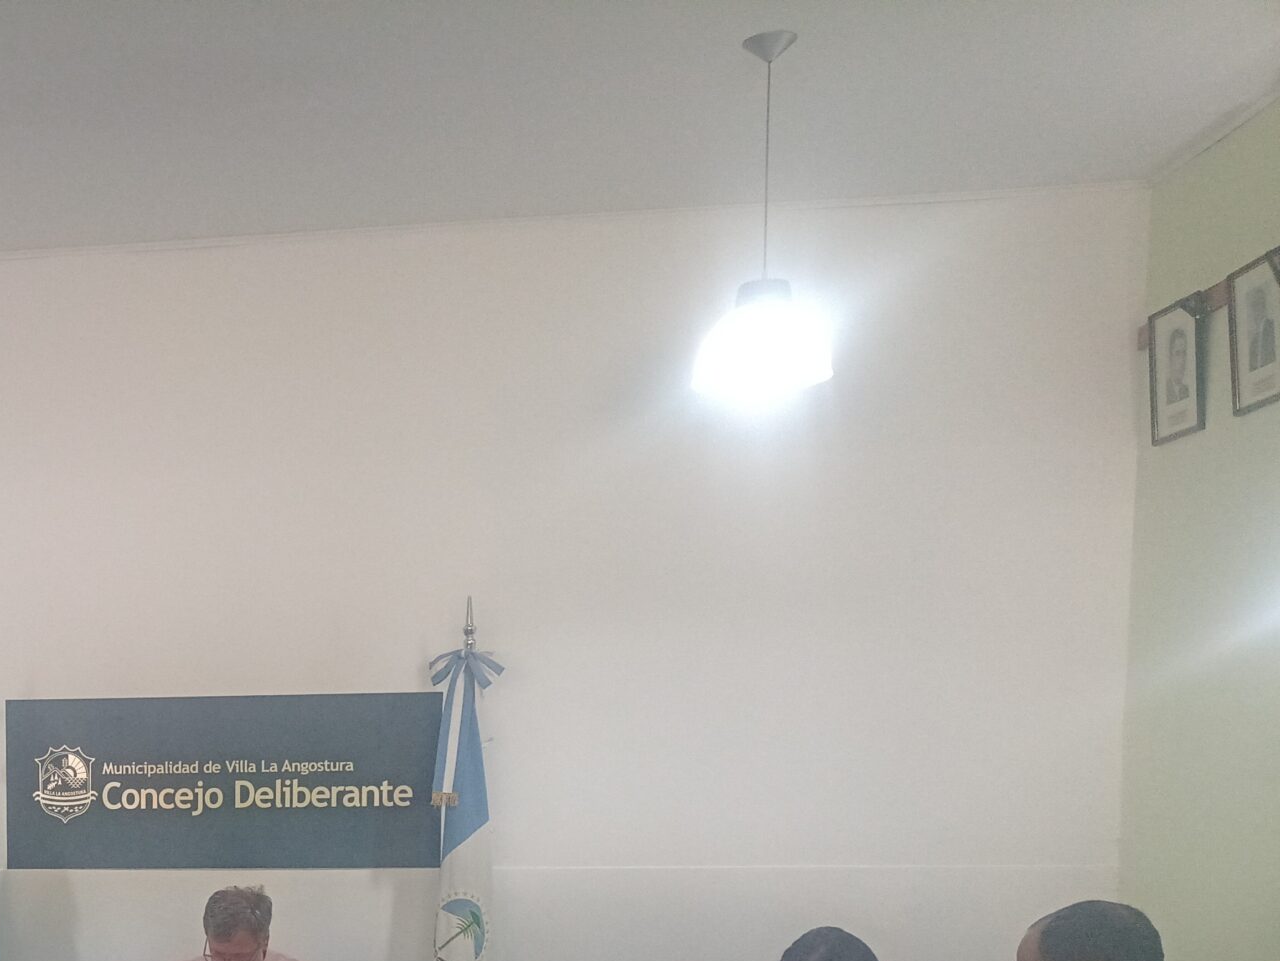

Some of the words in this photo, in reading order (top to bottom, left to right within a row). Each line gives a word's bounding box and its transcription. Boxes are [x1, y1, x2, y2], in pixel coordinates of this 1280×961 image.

[102, 761, 199, 777] Municipalidad
[203, 761, 221, 773] de
[225, 760, 257, 773] Villa
[261, 760, 278, 773] La
[282, 759, 355, 775] Angostura
[102, 780, 224, 816] Concejo
[234, 778, 414, 809] Deliberante
